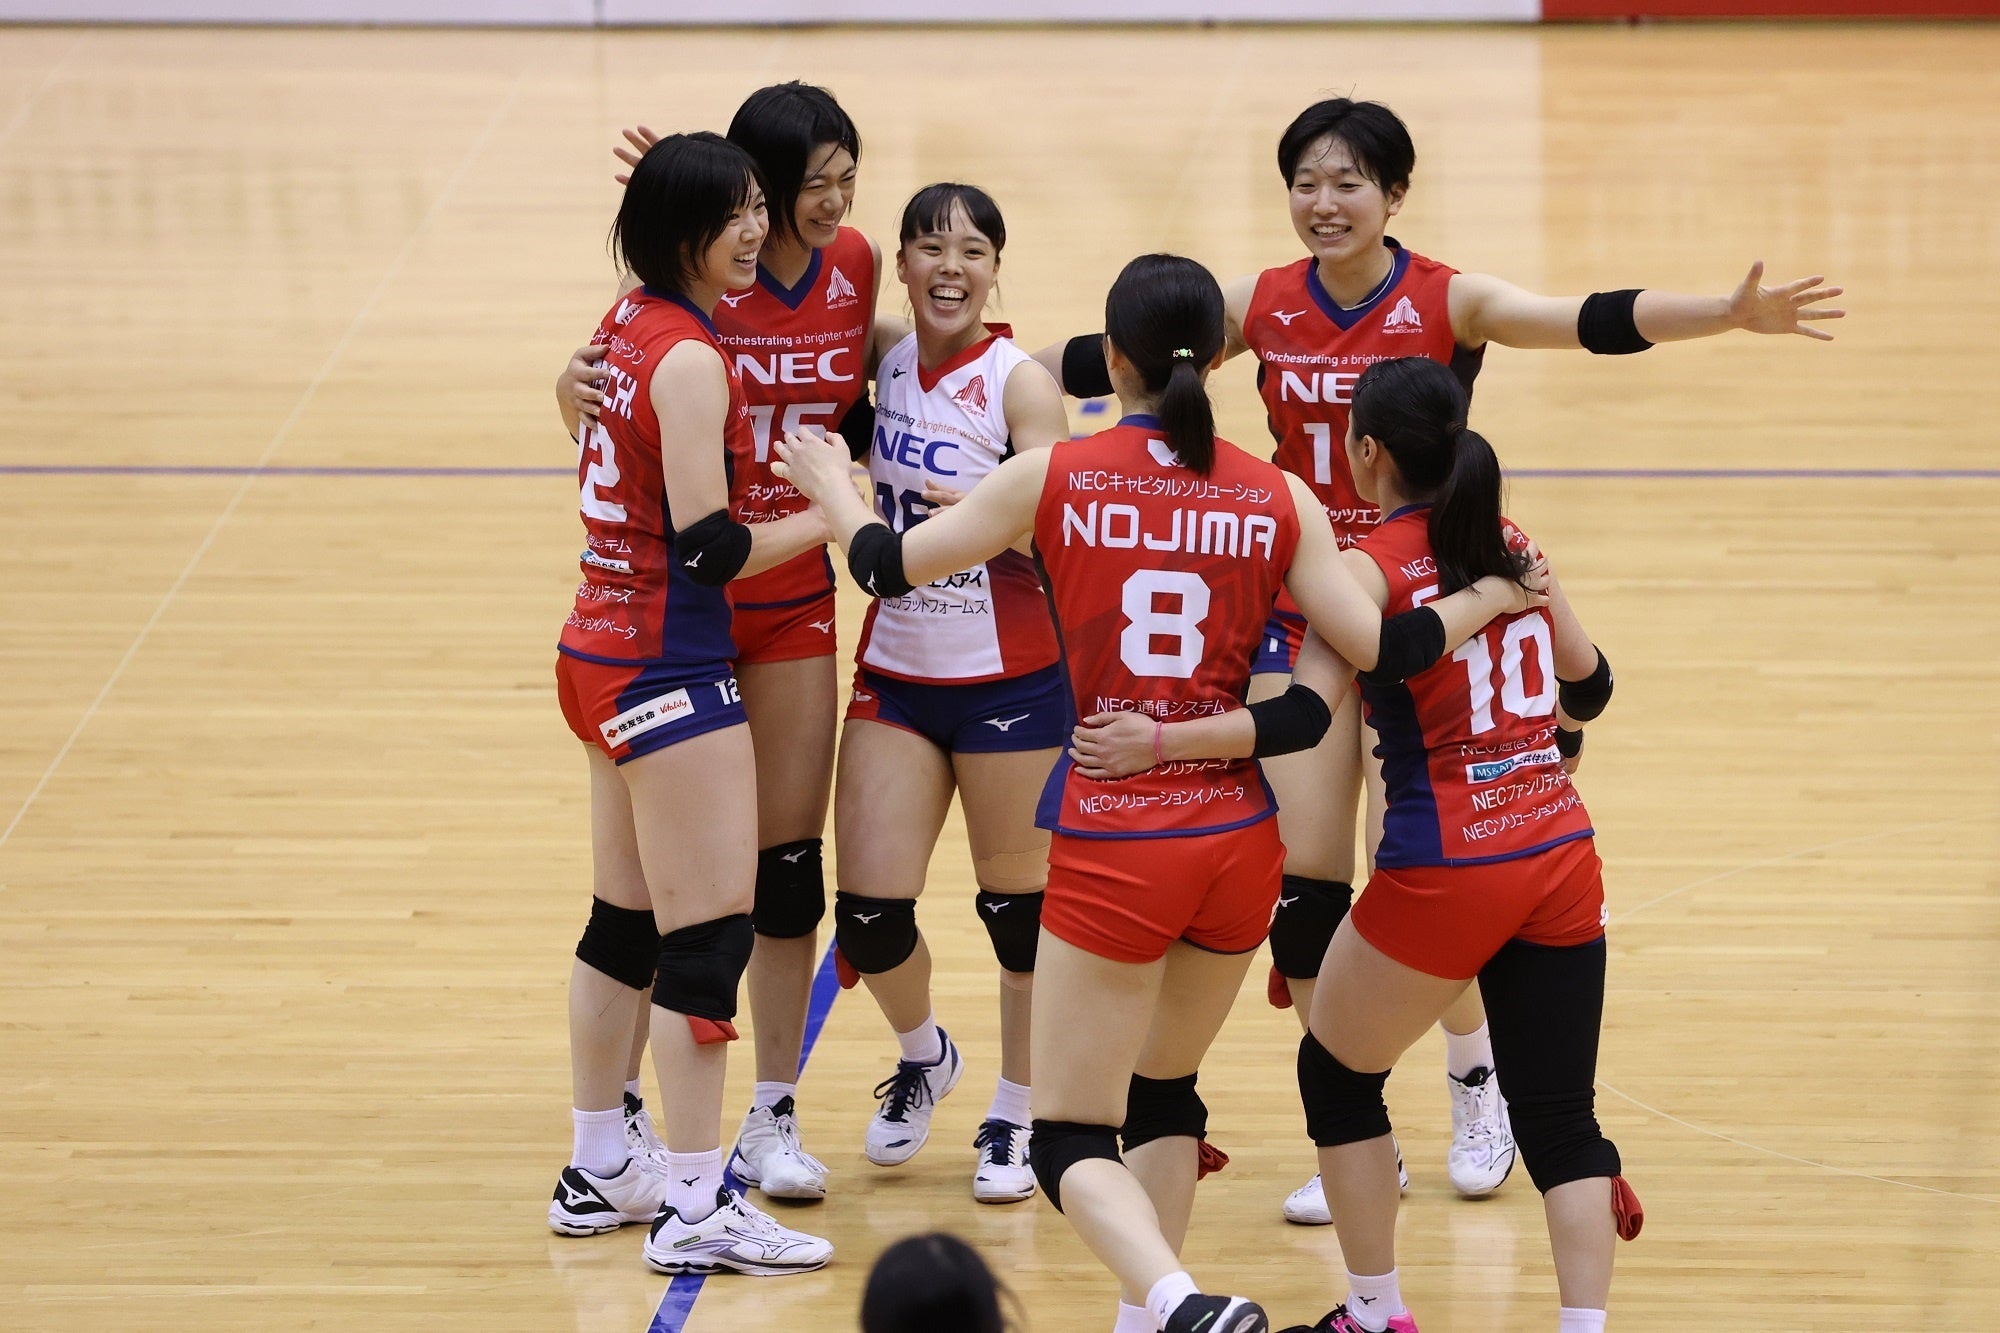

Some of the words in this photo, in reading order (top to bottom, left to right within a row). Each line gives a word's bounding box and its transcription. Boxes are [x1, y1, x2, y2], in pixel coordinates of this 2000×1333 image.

[717, 334, 792, 347] Orchestrating
[795, 336, 801, 344] a
[804, 331, 844, 345] brighter
[844, 324, 863, 339] world
[736, 347, 854, 384] NEC
[1266, 351, 1338, 367] Orchestrating
[1341, 356, 1347, 364] a
[1281, 370, 1360, 404] NE
[872, 425, 959, 476] NEC
[1069, 470, 1272, 504] NECキャピタルソリューション
[1062, 500, 1277, 561] NOJIMA
[1120, 568, 1211, 678] 8
[1452, 611, 1557, 735] 10
[715, 678, 741, 705] 12
[619, 710, 655, 733] 住友生命
[659, 699, 688, 714] Vitality
[1080, 785, 1244, 815] NECソリューションイノベータ
